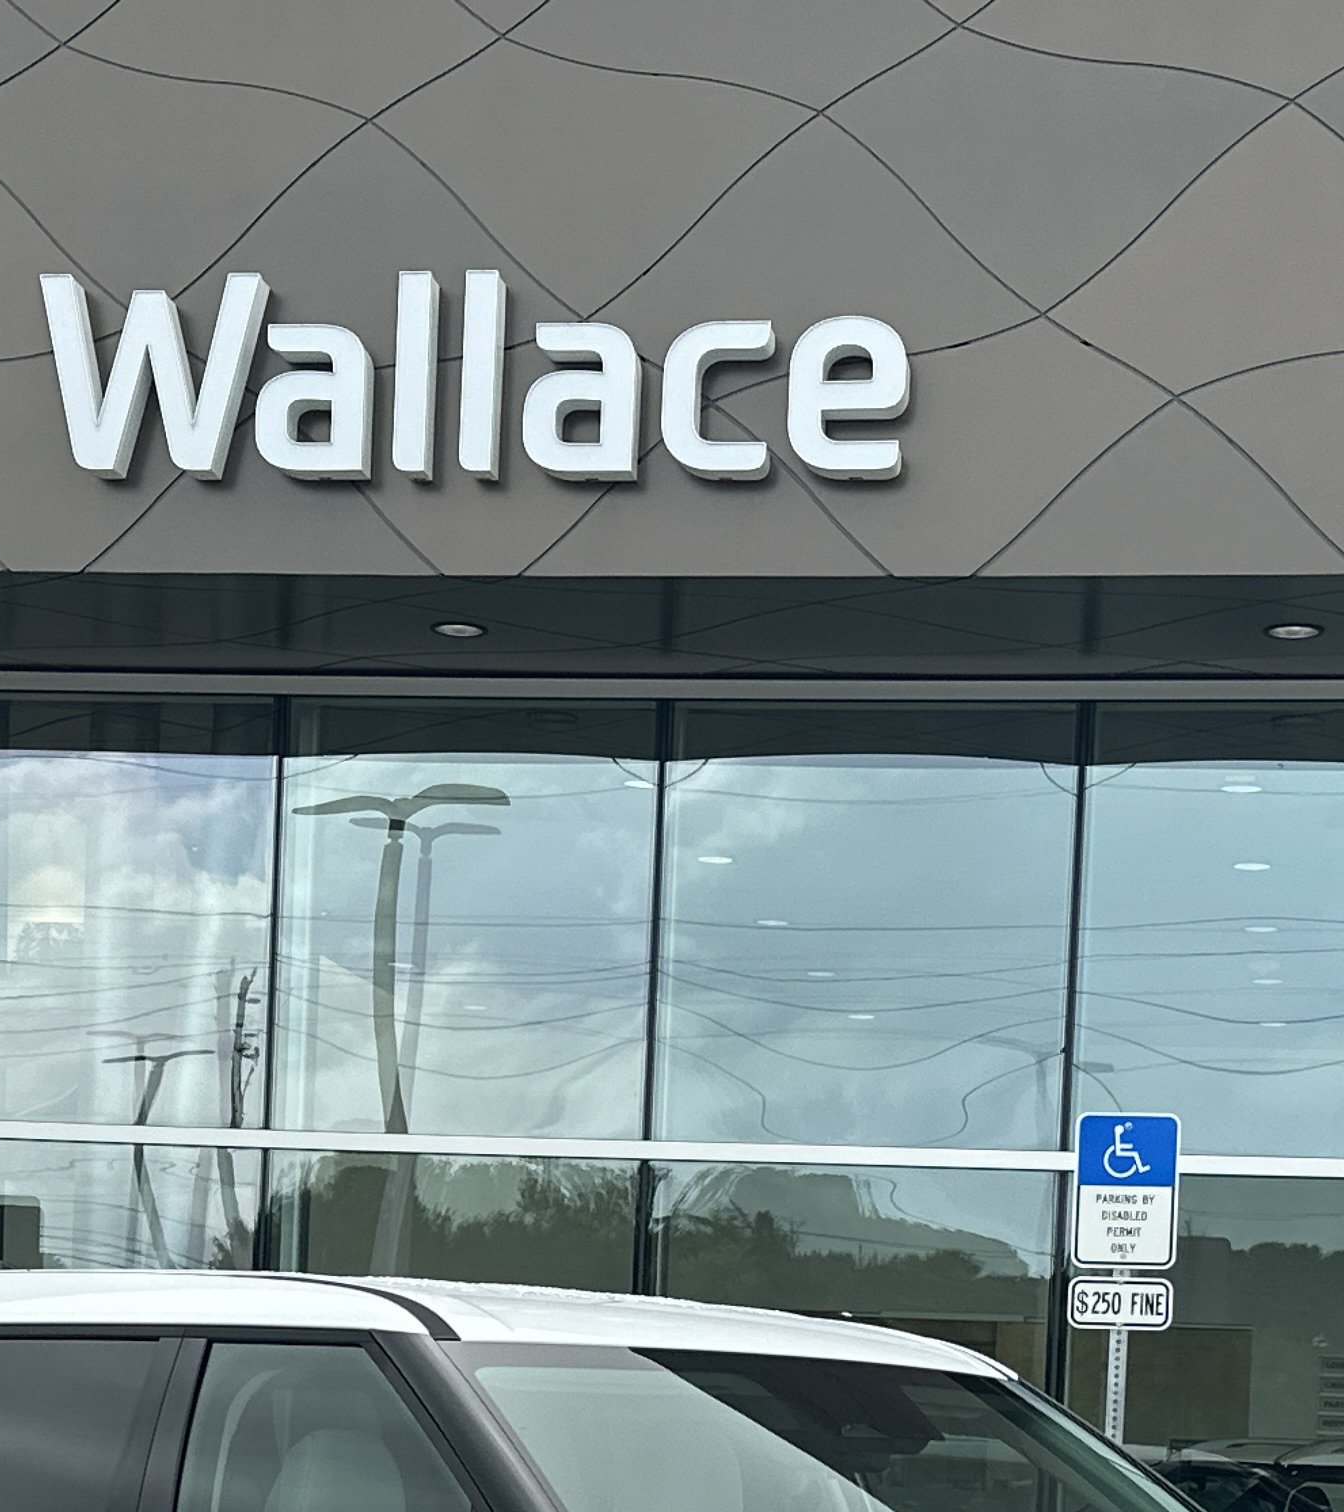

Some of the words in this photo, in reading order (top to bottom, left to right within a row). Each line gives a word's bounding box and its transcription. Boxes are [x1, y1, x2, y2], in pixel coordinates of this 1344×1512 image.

[39, 269, 911, 481] Wallace
[1096, 1194, 1138, 1204] PARKING
[1142, 1194, 1155, 1205] BY
[1102, 1210, 1148, 1221] DISABLED
[1107, 1227, 1142, 1237] PERMIT
[1110, 1243, 1136, 1253] ONLY
[1076, 1289, 1122, 1316] $250
[1130, 1292, 1164, 1316] FINE
